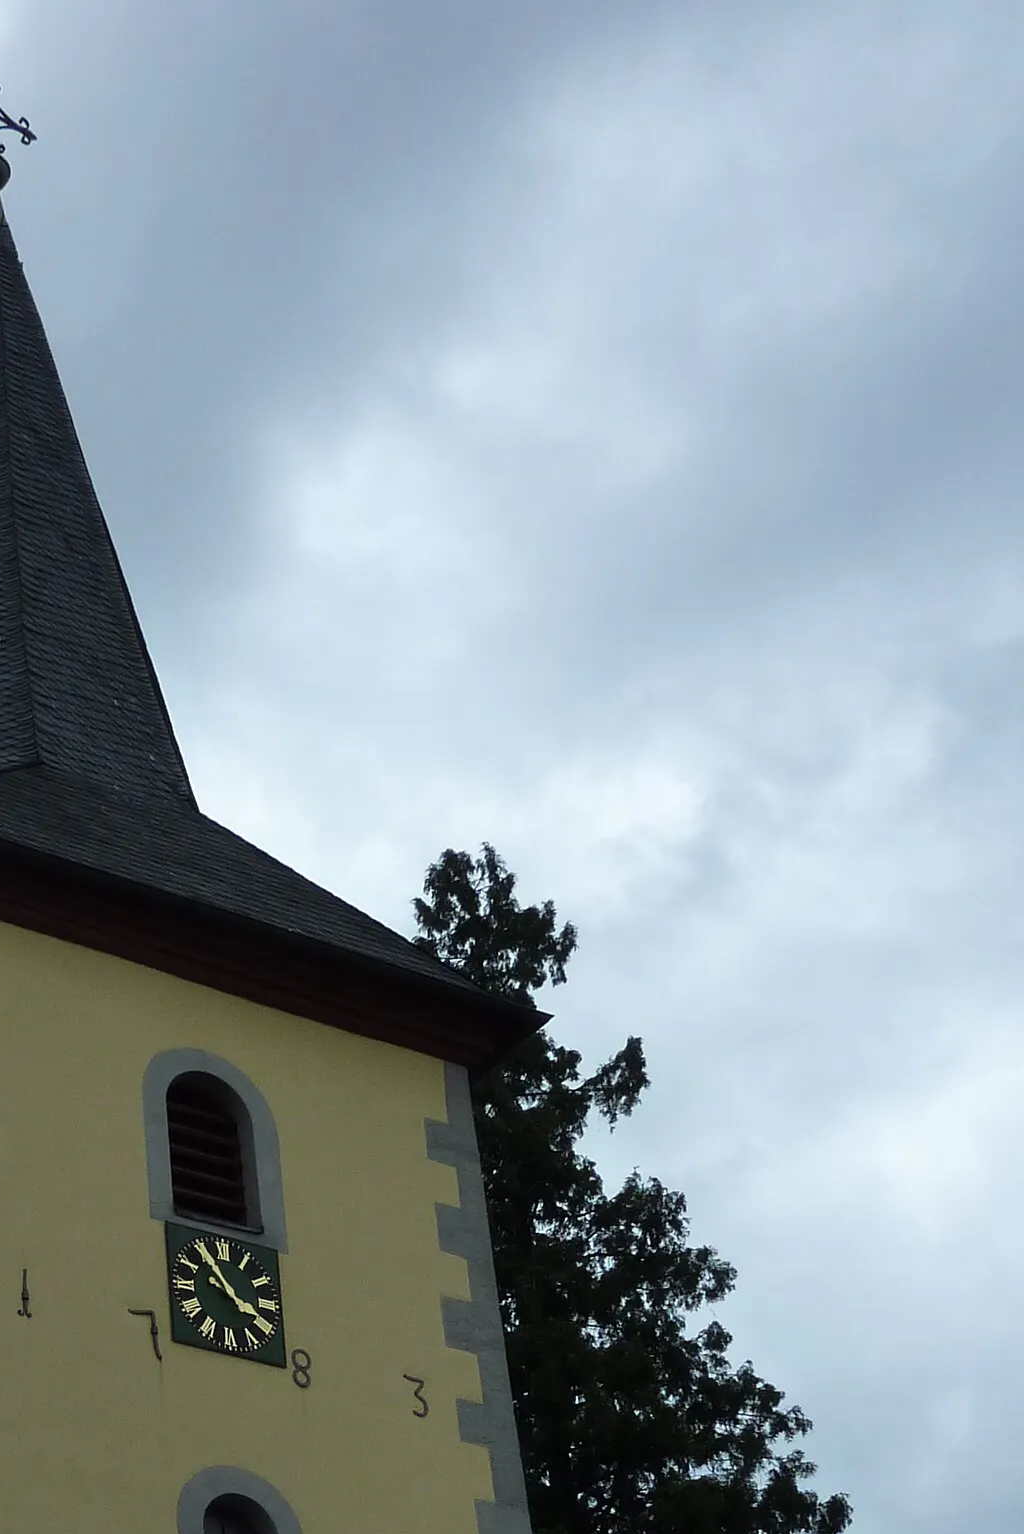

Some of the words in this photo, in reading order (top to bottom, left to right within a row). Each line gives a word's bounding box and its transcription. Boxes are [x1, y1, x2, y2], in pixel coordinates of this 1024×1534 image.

[215, 1241, 230, 1261] XII
[180, 1255, 199, 1274] X
[238, 1254, 250, 1271] I
[251, 1275, 268, 1288] II
[258, 1297, 276, 1312] III
[224, 1326, 237, 1347] VI
[244, 1327, 259, 1347] V
[128, 1308, 162, 1362] 7
[291, 1348, 311, 1388] 8
[403, 1374, 429, 1417] 3
